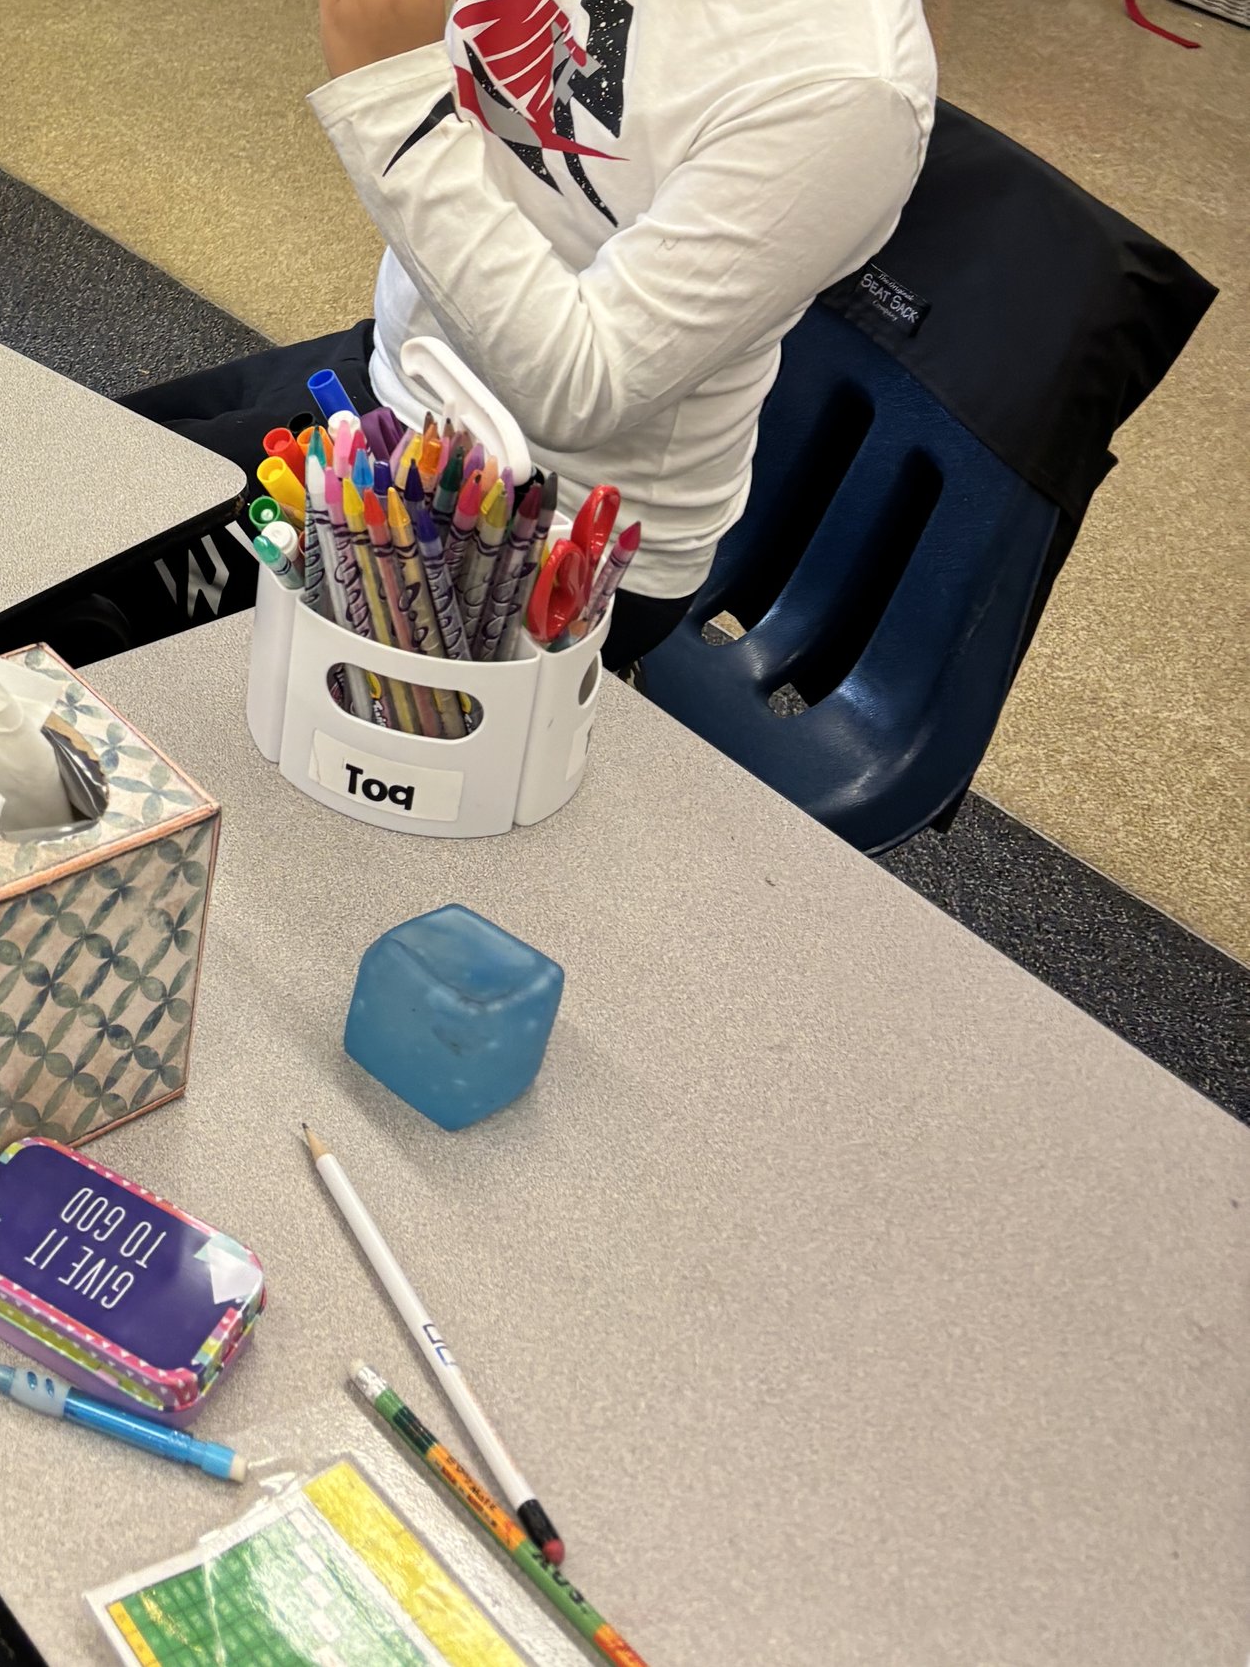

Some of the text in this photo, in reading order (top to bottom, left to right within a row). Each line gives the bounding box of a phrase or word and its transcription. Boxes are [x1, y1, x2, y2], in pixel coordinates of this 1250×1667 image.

[861, 274, 918, 323] SEAT SACK
[345, 763, 415, 811] Toq
[60, 1187, 168, 1269] TO GOD
[23, 1228, 135, 1310] GIVE IT
